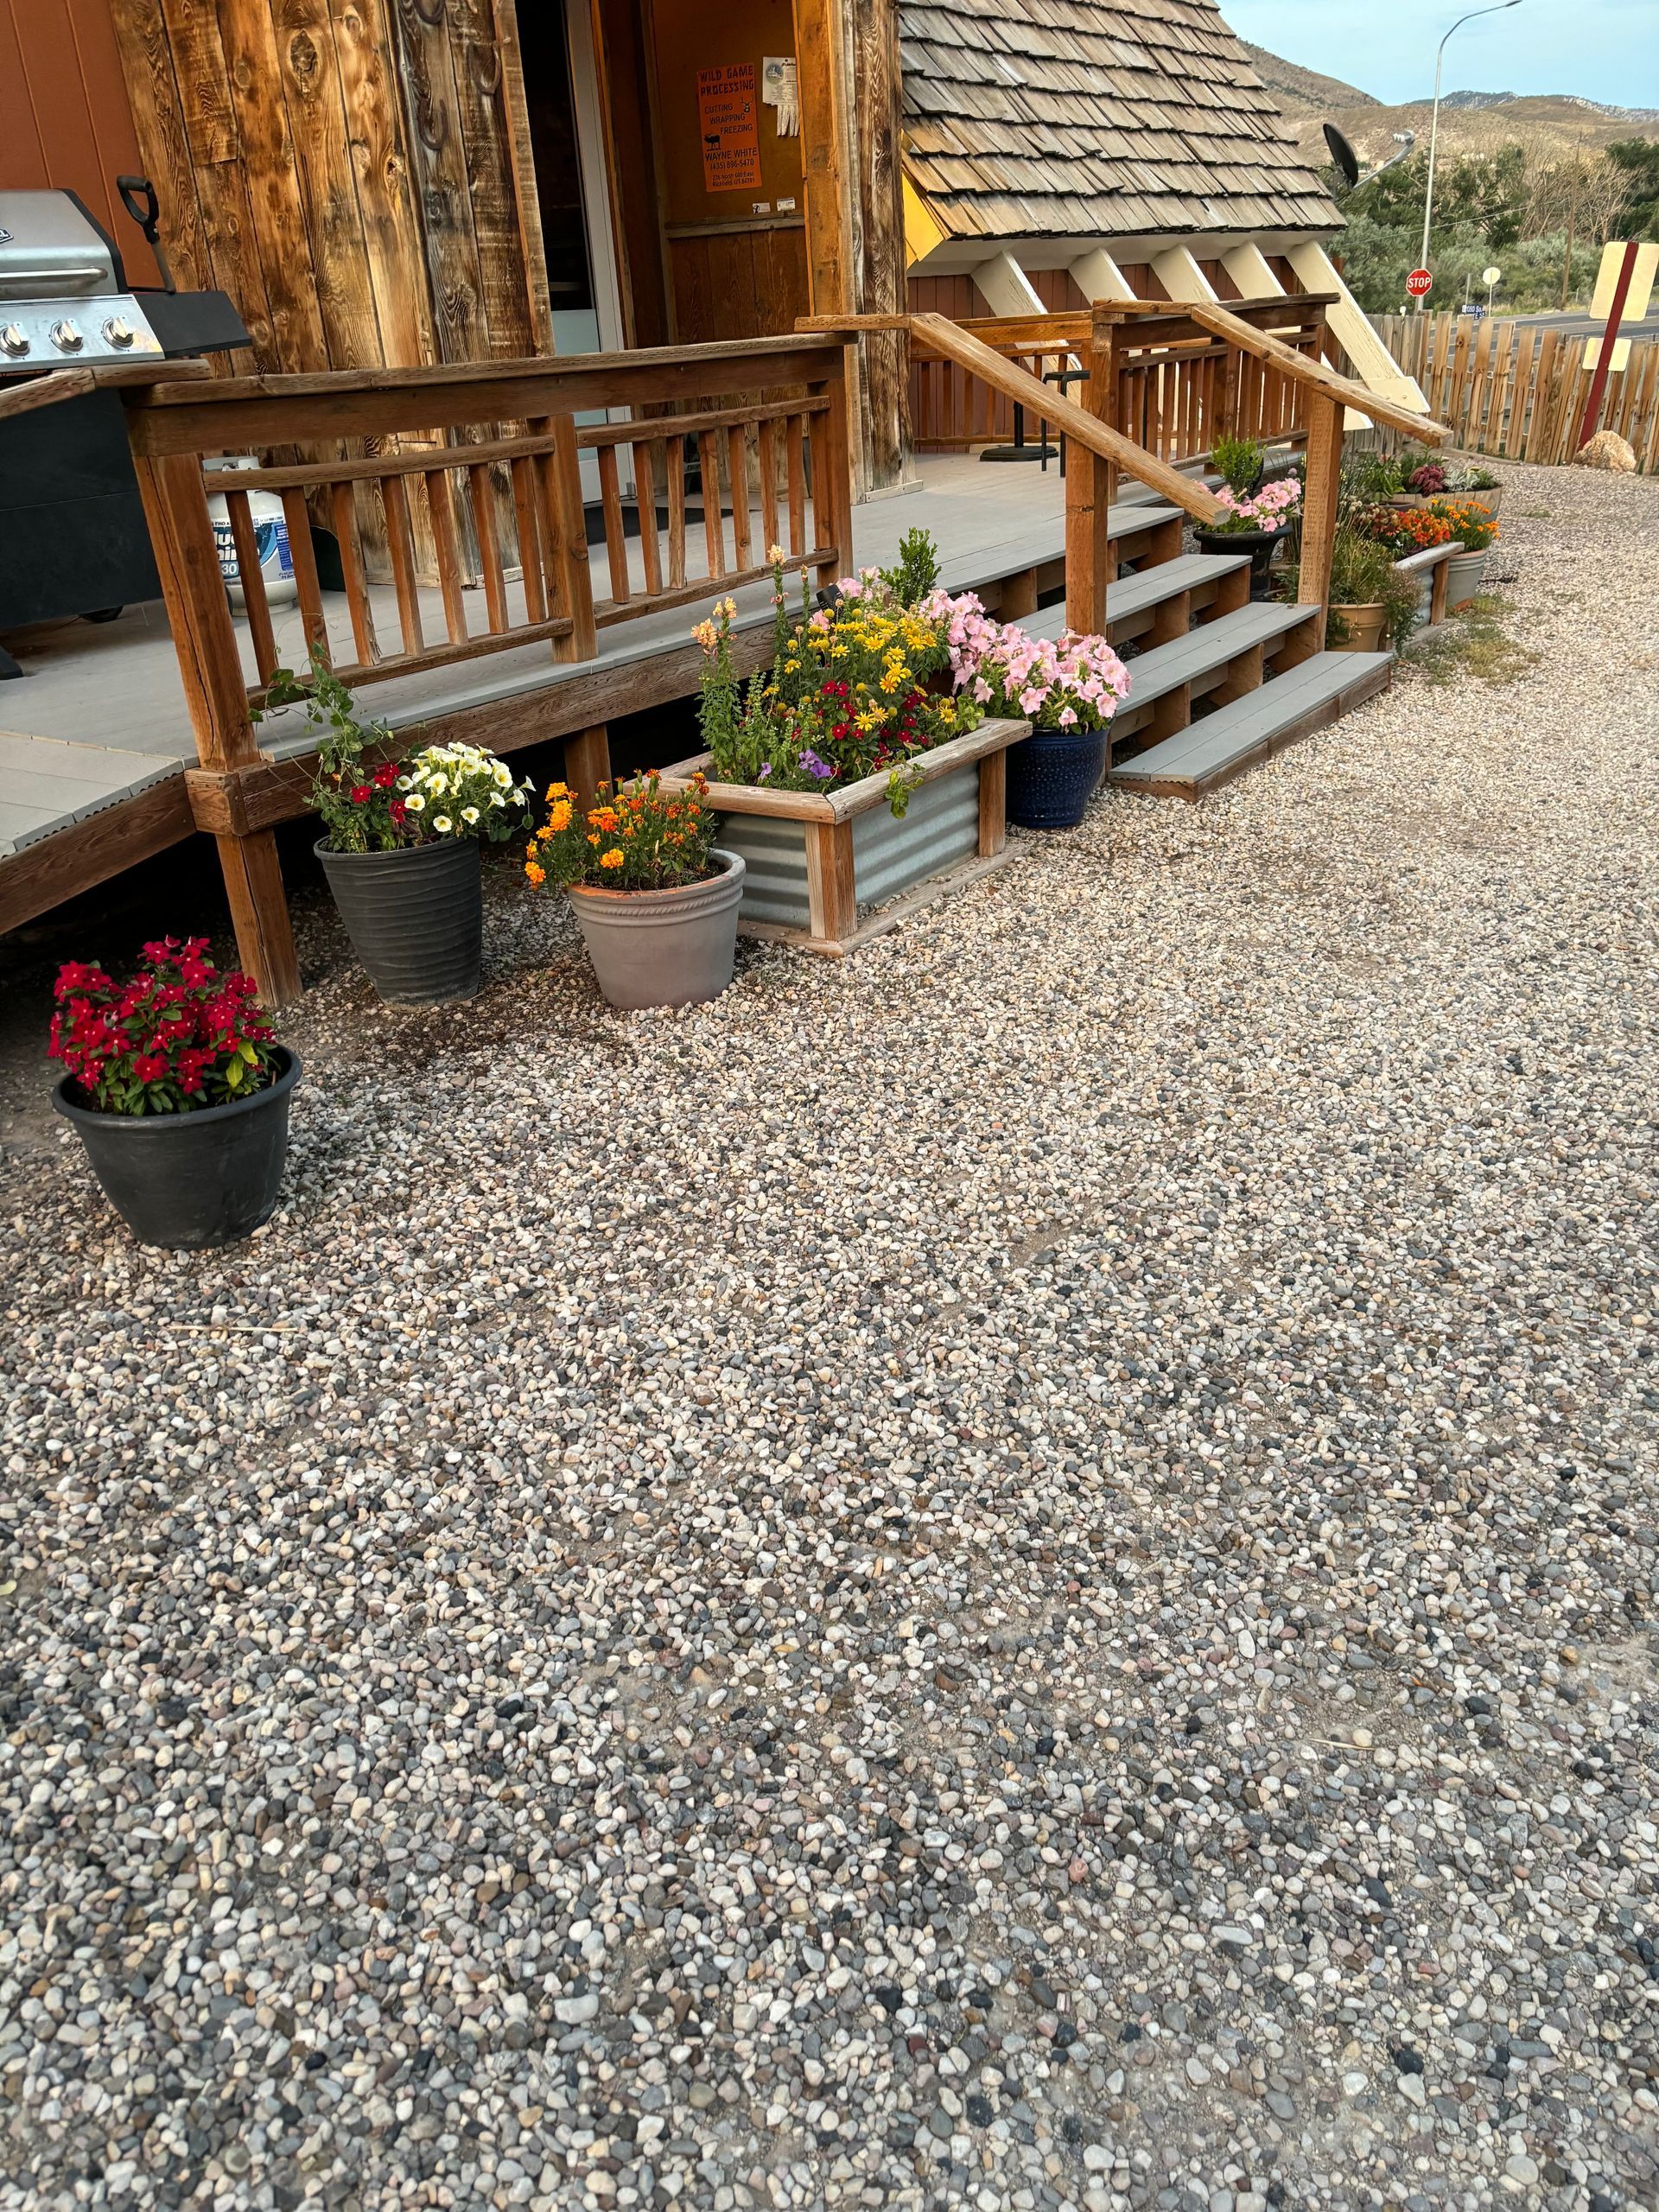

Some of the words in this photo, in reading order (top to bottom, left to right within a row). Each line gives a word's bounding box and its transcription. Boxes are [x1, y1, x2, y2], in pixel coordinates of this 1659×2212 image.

[701, 70, 721, 82] WILD
[728, 66, 753, 79] GAME
[701, 79, 753, 96] PROCESSING
[705, 104, 733, 113] CUTTING
[709, 112, 746, 124] WRAPPING
[720, 124, 753, 135] FREEZING
[705, 150, 732, 162] WAYNE
[734, 148, 757, 157] WHITE
[710, 160, 726, 171] (435)
[1408, 277, 1431, 289] STOP
[221, 563, 237, 575] 30
